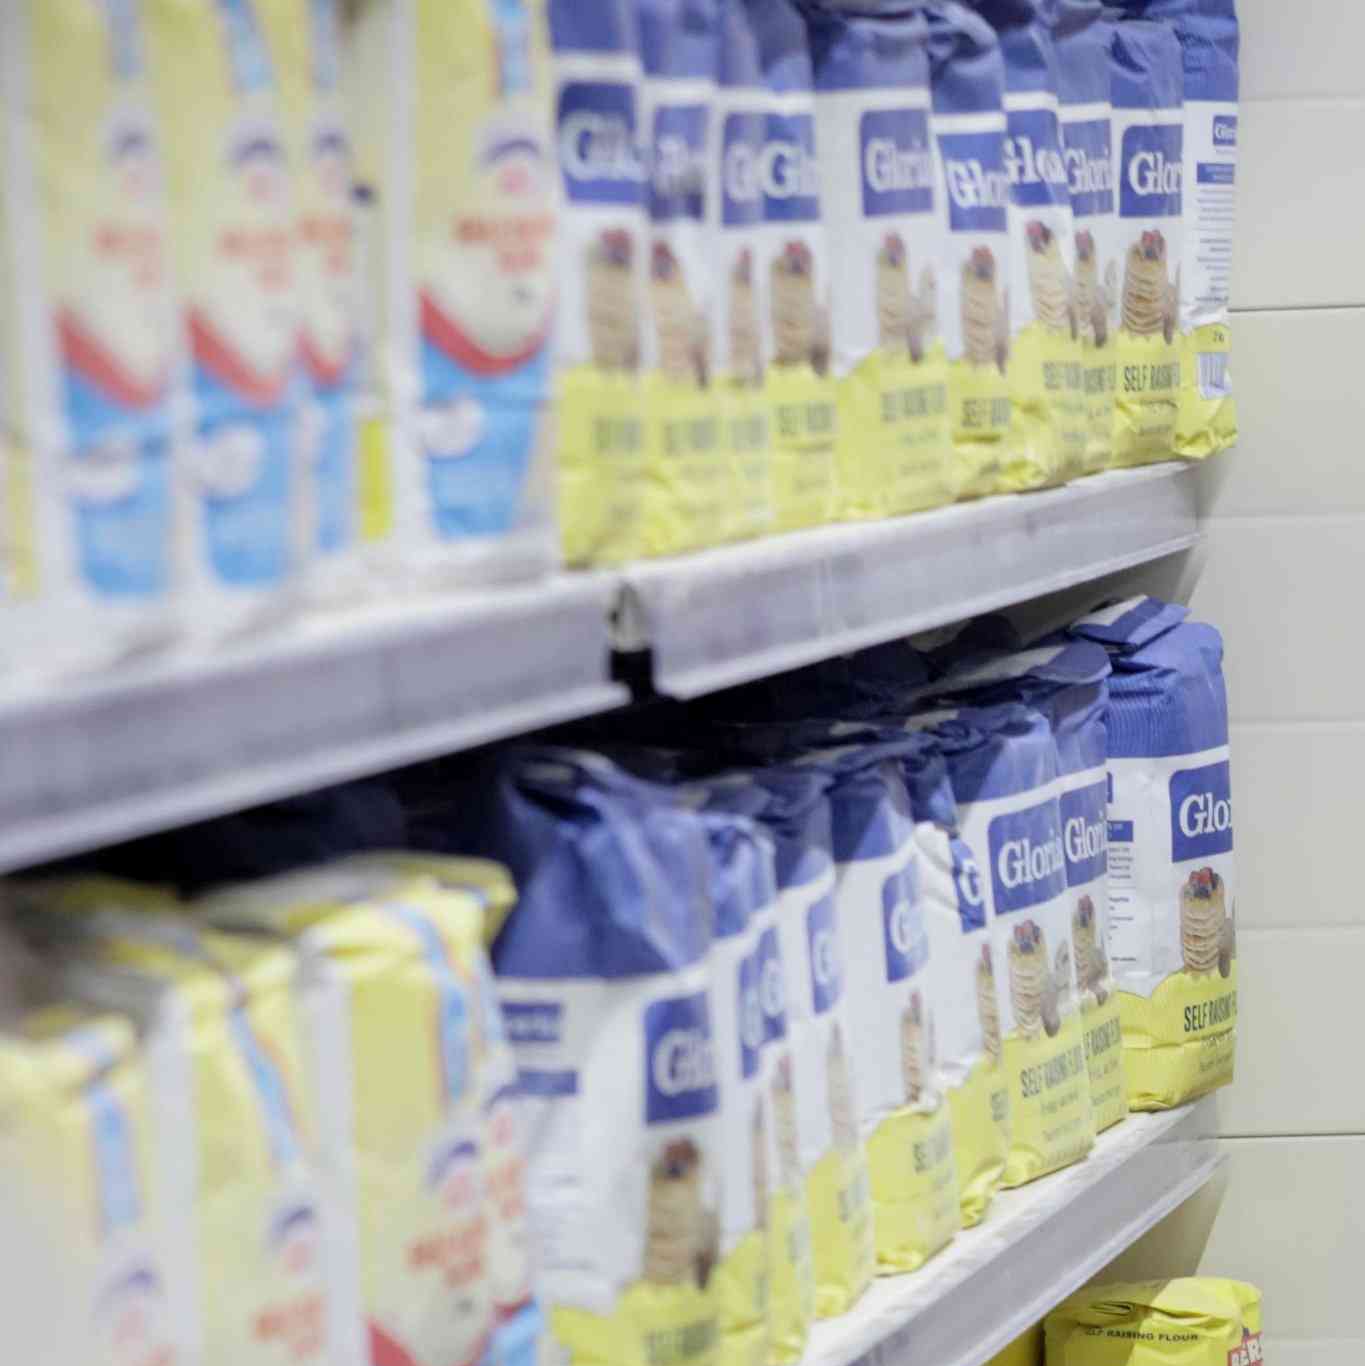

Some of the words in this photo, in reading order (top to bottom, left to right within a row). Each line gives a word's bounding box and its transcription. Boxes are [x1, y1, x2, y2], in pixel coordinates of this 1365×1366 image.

[1184, 1001, 1209, 1033] SELF
[1106, 1329, 1155, 1341] RAISING
[1158, 1333, 1200, 1341] FLOUR
